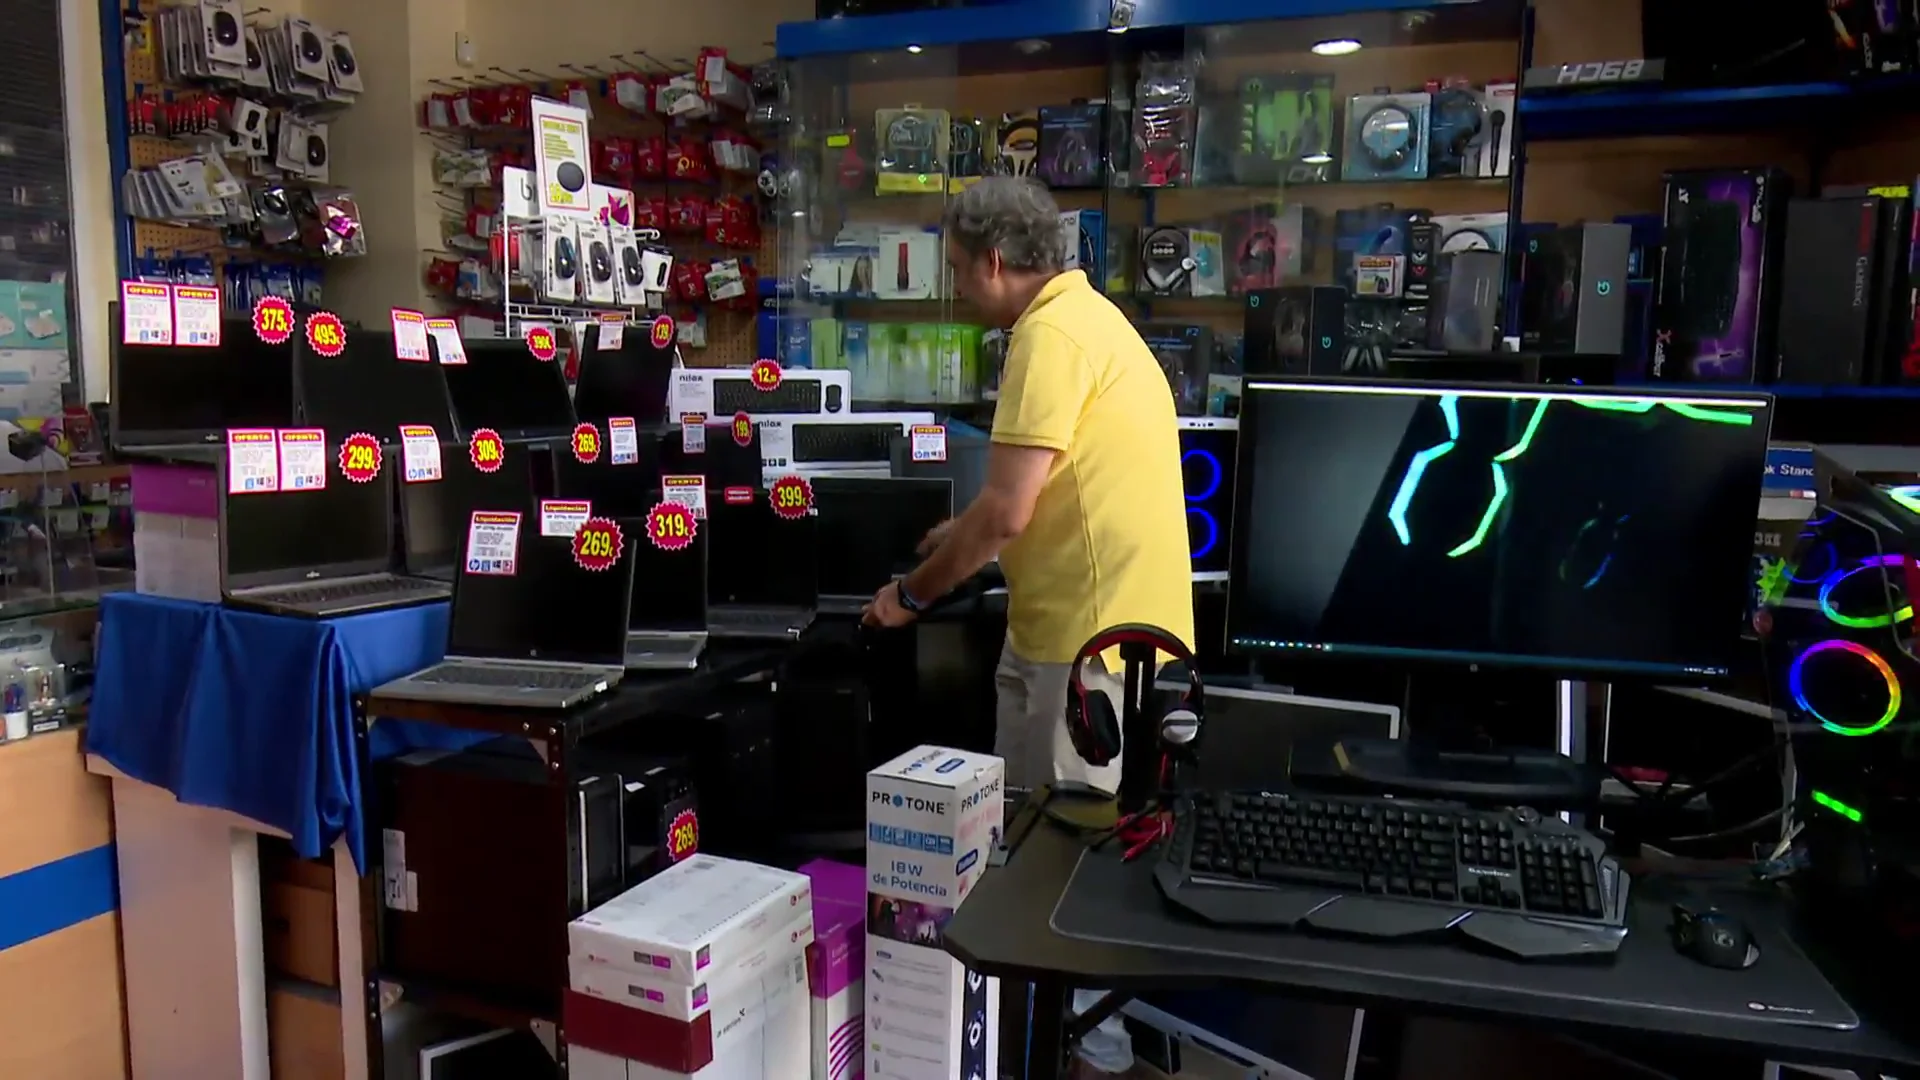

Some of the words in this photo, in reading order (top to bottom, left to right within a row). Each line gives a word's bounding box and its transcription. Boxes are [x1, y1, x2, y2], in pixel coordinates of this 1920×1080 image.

[128, 286, 166, 296] OFERTA
[179, 290, 214, 299] OFERTA
[234, 433, 270, 441] OFERTA
[284, 433, 320, 441] OFERTA
[777, 486, 806, 508] 399€
[656, 513, 688, 537] 319€
[580, 530, 614, 557] 269€
[872, 791, 945, 816] PROTONE
[873, 872, 887, 885] de
[891, 876, 948, 897] Potencia
